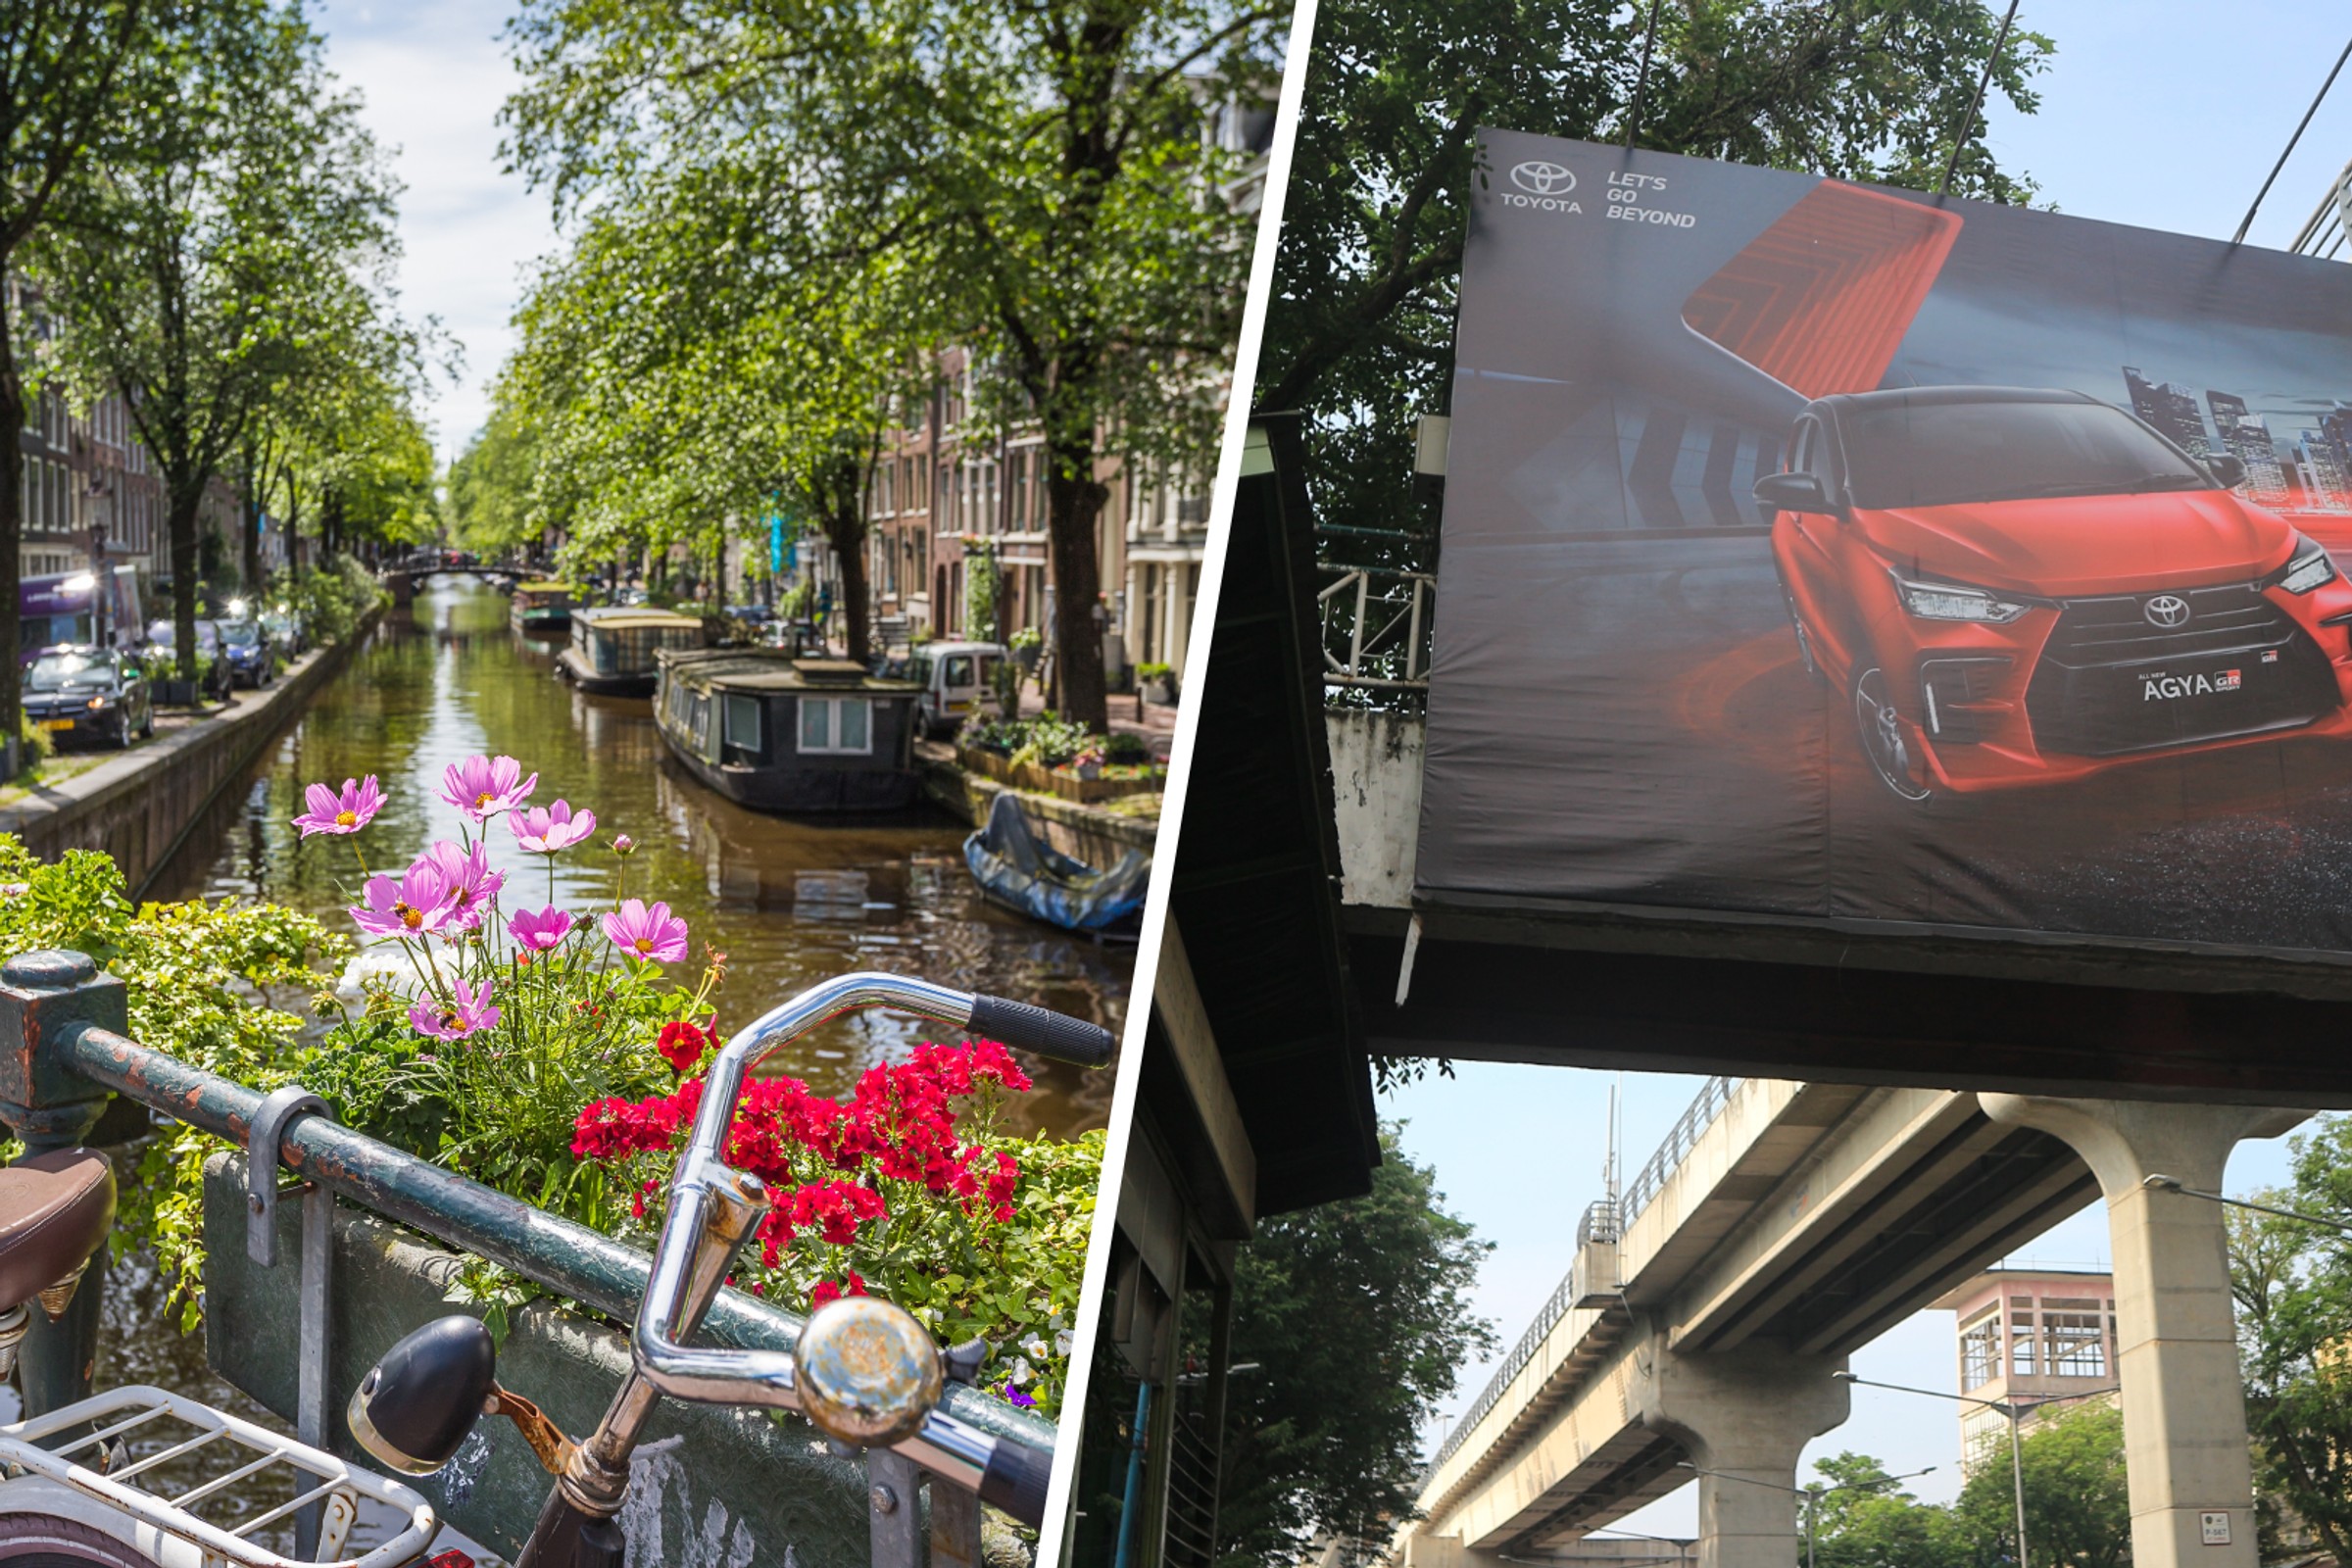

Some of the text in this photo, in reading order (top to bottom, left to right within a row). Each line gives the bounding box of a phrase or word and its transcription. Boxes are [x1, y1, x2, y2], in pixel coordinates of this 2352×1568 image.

[1607, 172, 1667, 190] LET'S
[1500, 193, 1583, 214] TOYOTA
[1606, 188, 1638, 204] GO
[1606, 205, 1696, 228] BEYOND
[2144, 673, 2240, 701] AGYA GR
